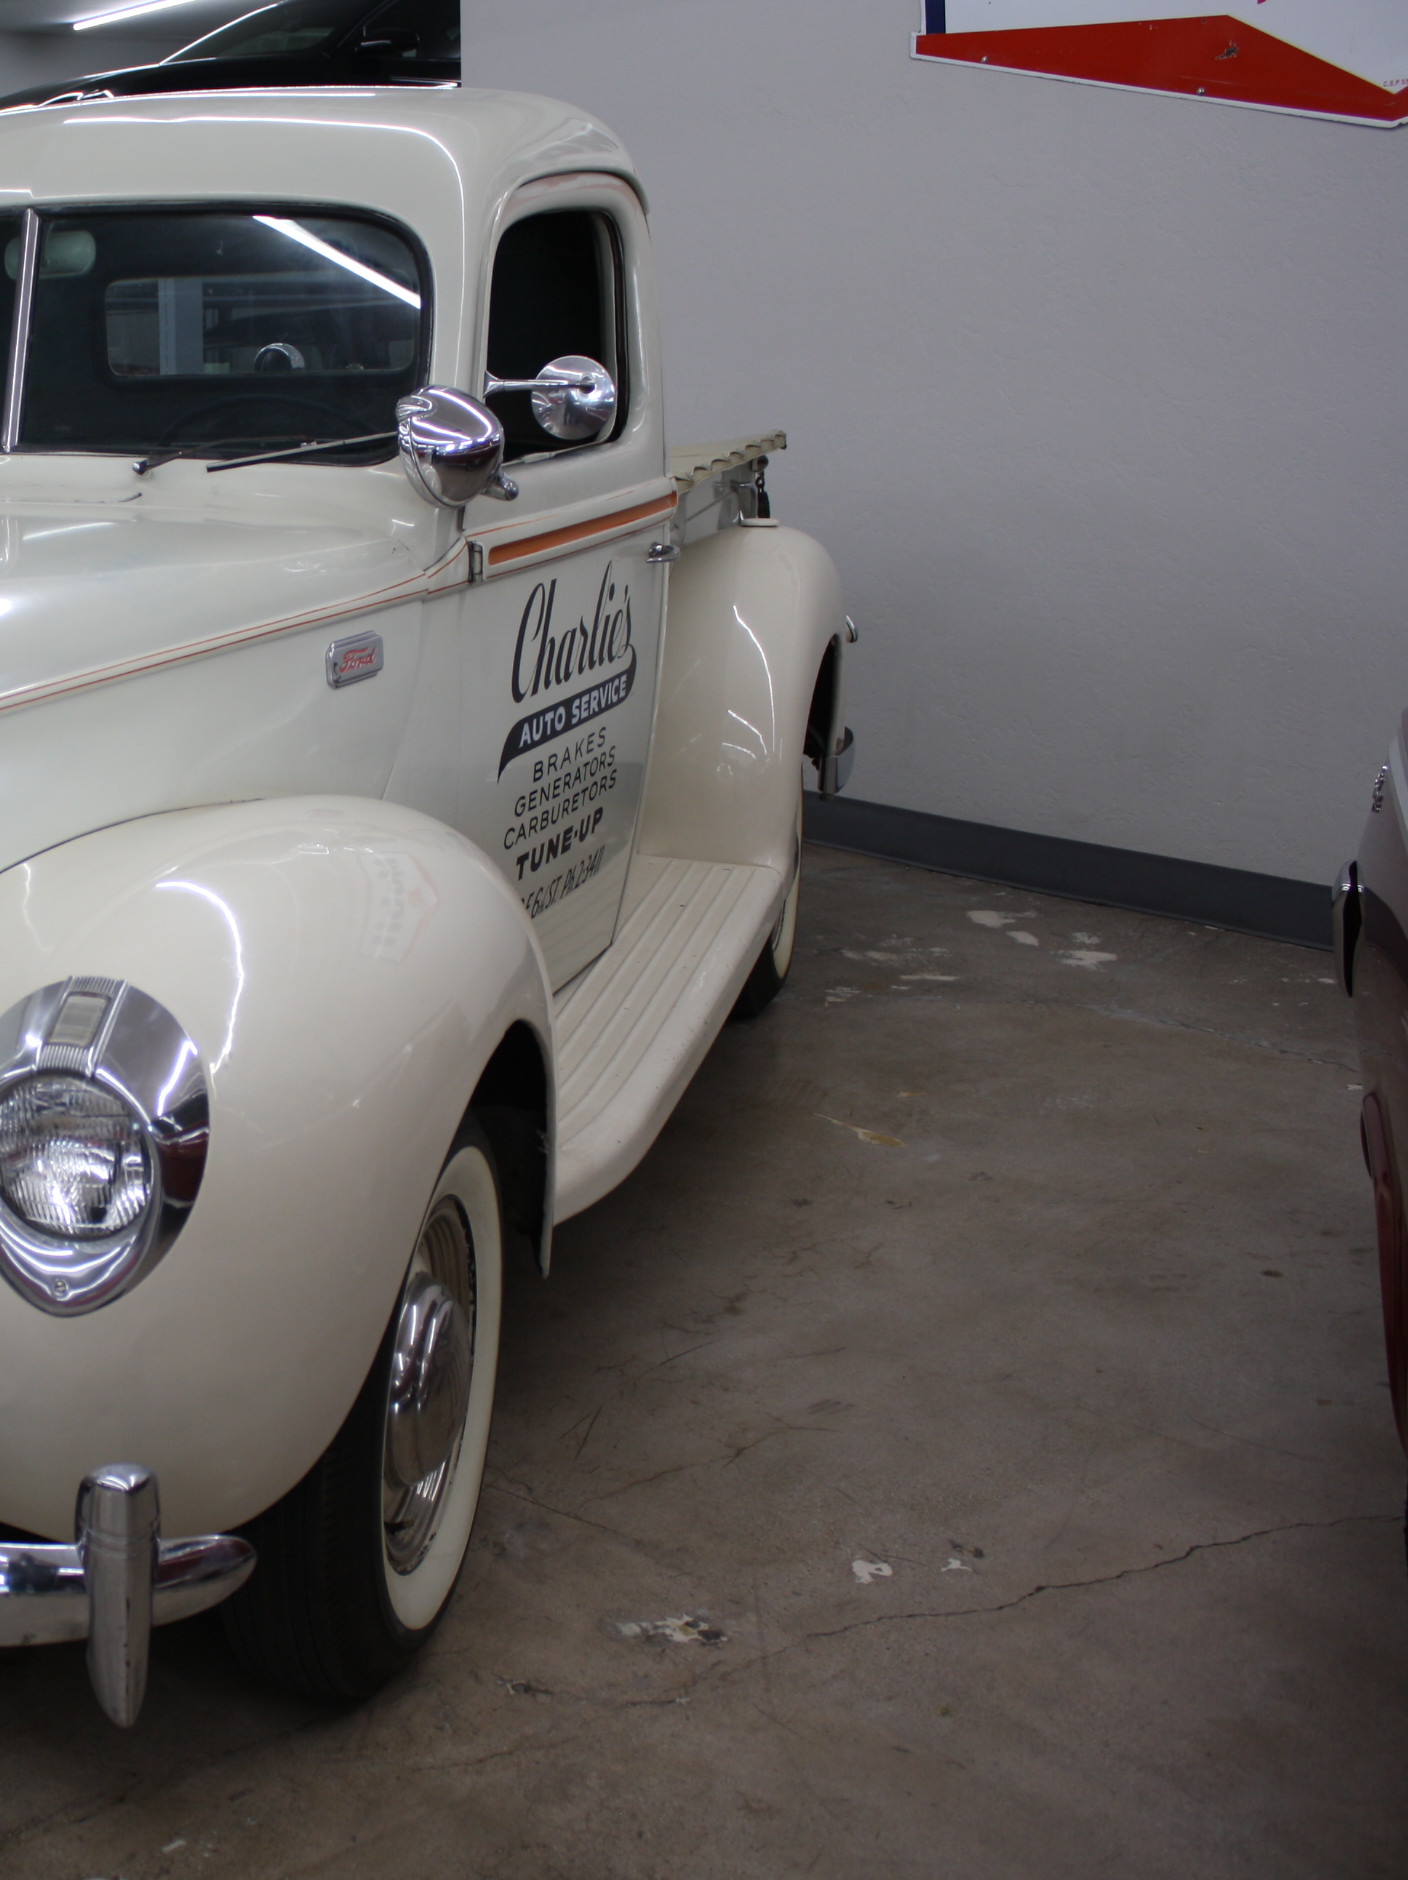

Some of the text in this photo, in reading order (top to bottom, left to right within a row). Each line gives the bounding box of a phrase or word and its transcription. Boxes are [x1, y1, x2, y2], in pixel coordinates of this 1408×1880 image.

[339, 647, 378, 673] Ford
[511, 560, 633, 704] Charlie's
[518, 673, 628, 749] AUTO SERVICE
[514, 745, 616, 818] GENERATORS
[532, 726, 607, 783] BRAKES
[504, 769, 618, 850] CARBURETORS
[515, 806, 604, 881] TUNE-UP
